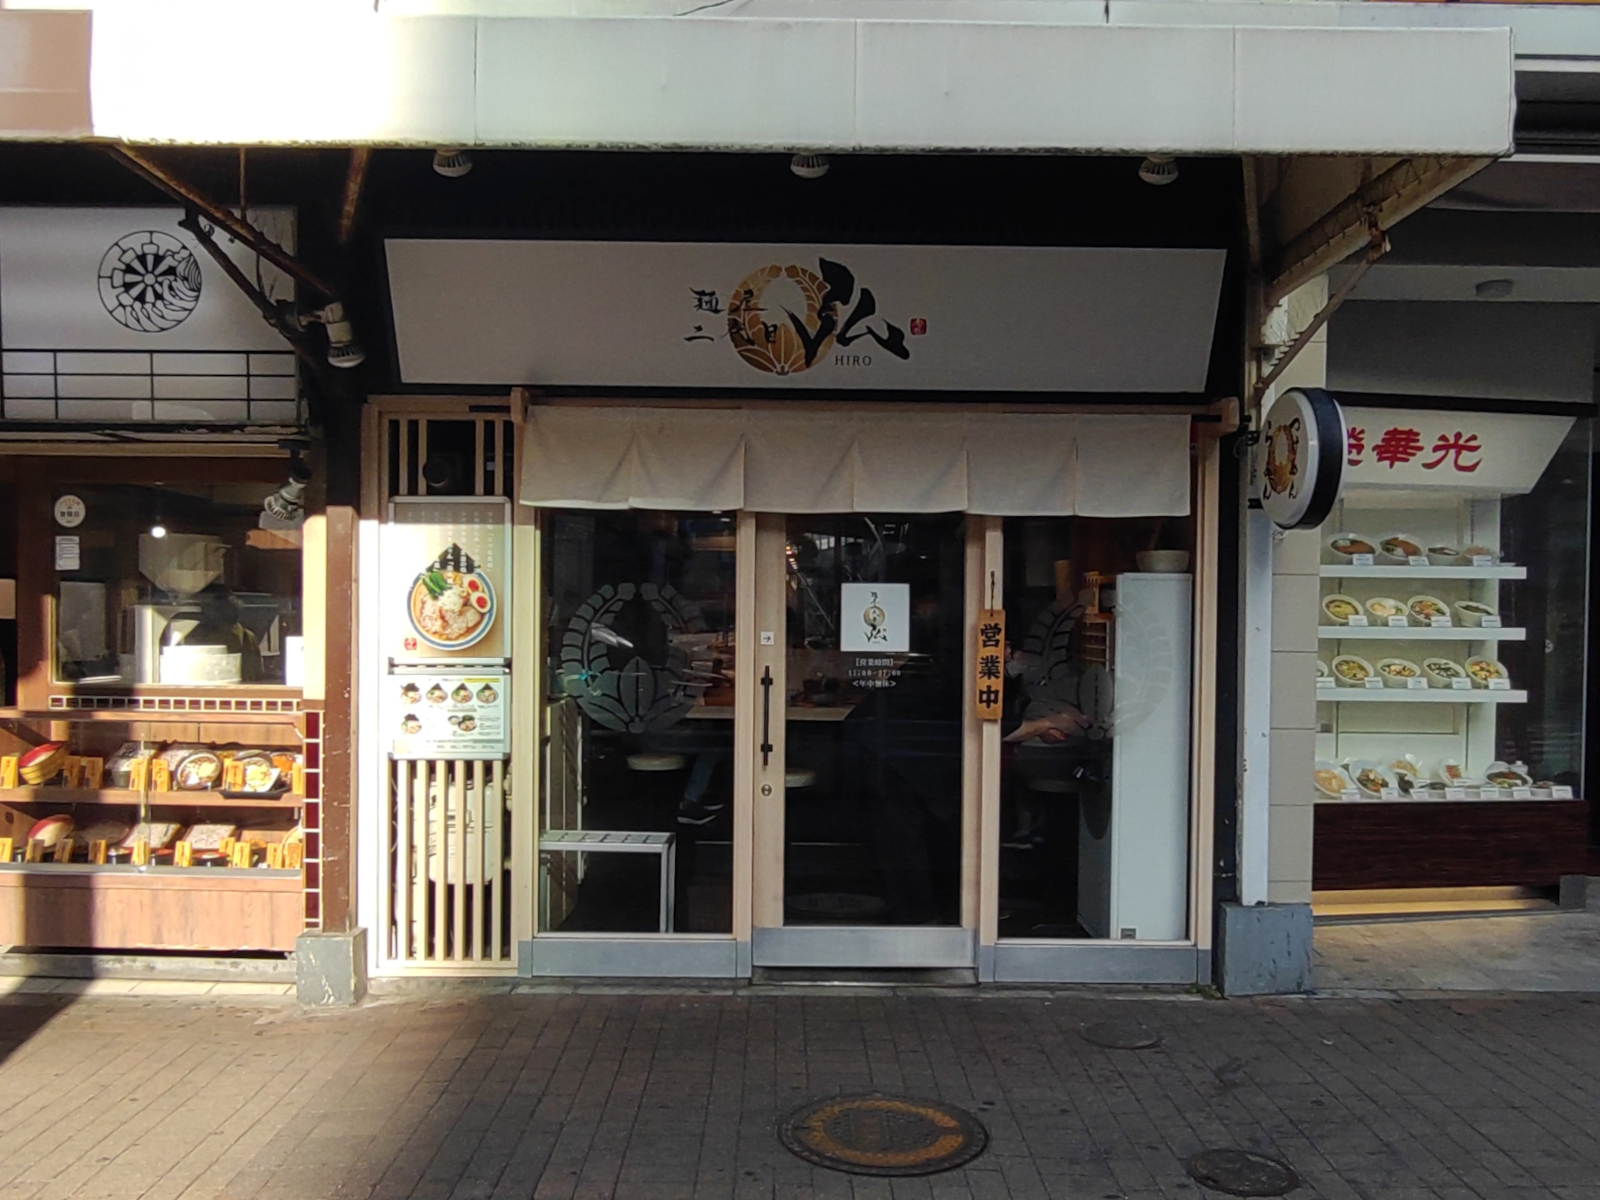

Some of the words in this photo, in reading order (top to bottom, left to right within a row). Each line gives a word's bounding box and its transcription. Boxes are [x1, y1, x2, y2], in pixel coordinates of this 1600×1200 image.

[834, 355, 872, 366] HIRO
[978, 623, 1002, 710] 営業中
